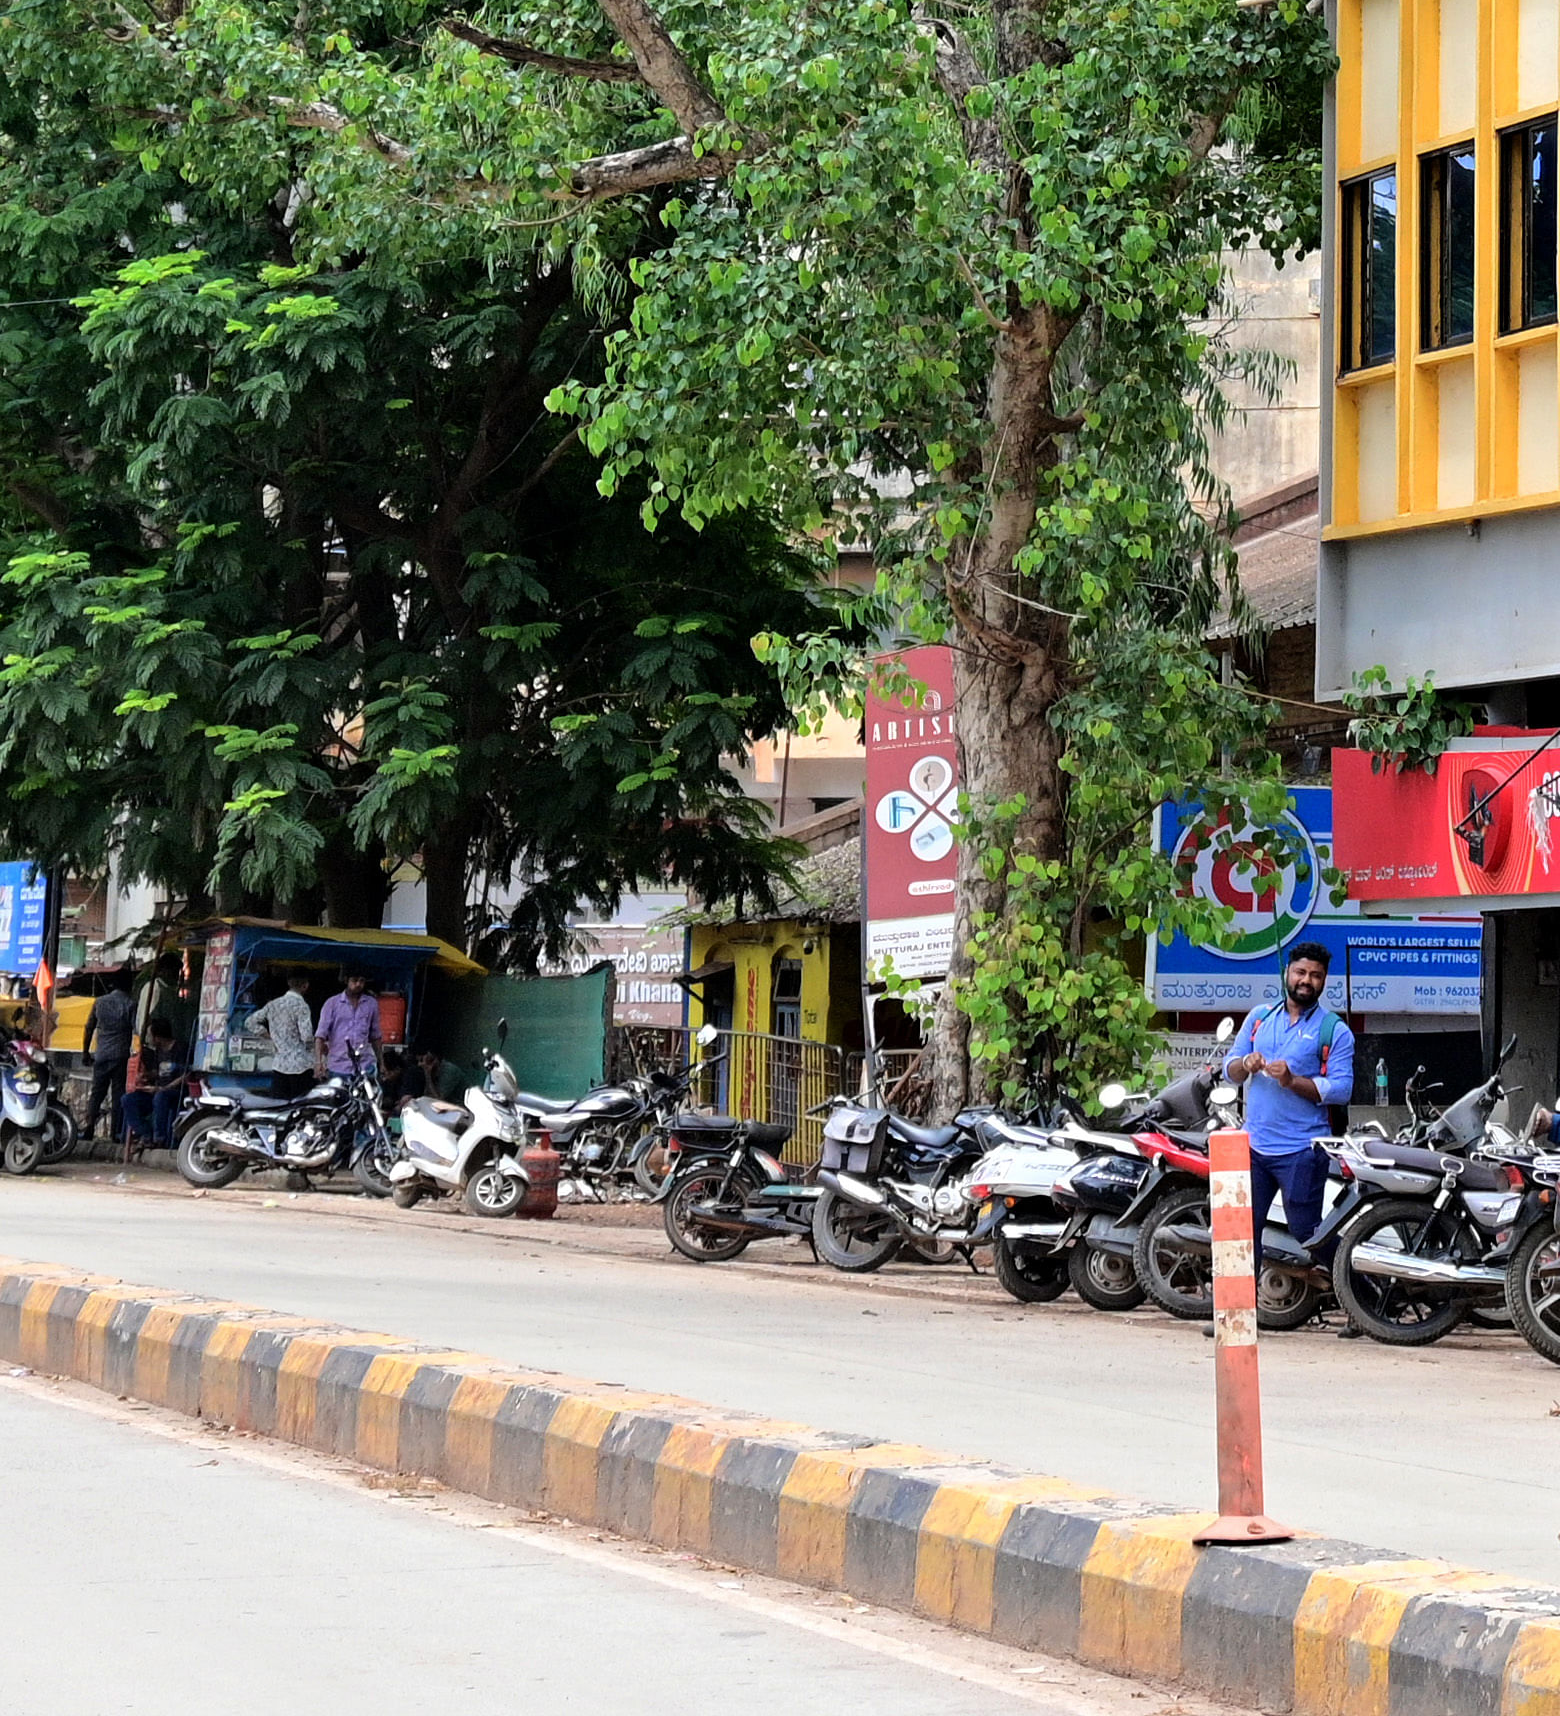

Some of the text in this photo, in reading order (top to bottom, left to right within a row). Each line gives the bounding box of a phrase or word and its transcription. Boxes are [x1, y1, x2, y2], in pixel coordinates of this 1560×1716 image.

[1347, 936, 1396, 947] WORLD'S
[1398, 937, 1444, 947] LARGEST
[874, 944, 925, 955] MUTTURAJ
[1358, 951, 1478, 964] CPVC PIPES & FITTINGS
[630, 981, 682, 1003] Khana
[1162, 980, 1252, 1005] ಮುತ್ತುರಾಜ
[1414, 985, 1436, 996] Mob
